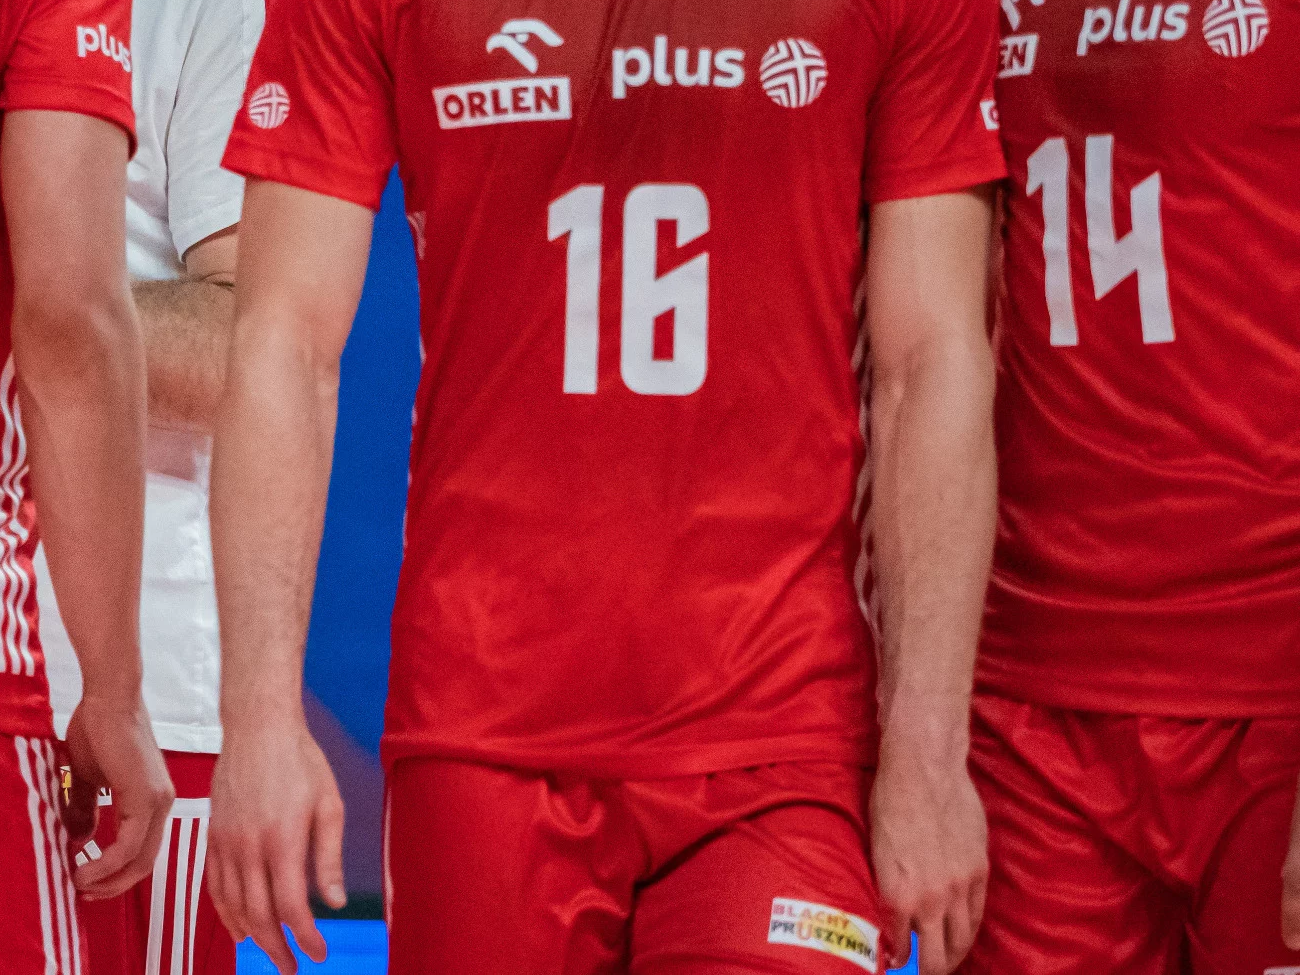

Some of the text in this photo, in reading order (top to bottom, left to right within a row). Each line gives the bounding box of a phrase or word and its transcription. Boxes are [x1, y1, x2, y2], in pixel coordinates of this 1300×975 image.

[76, 24, 131, 72] plus
[611, 35, 746, 99] plus
[443, 85, 561, 122] ORLEN
[1026, 135, 1175, 346] 14
[547, 182, 710, 396] 16
[772, 904, 850, 931] BLACHY
